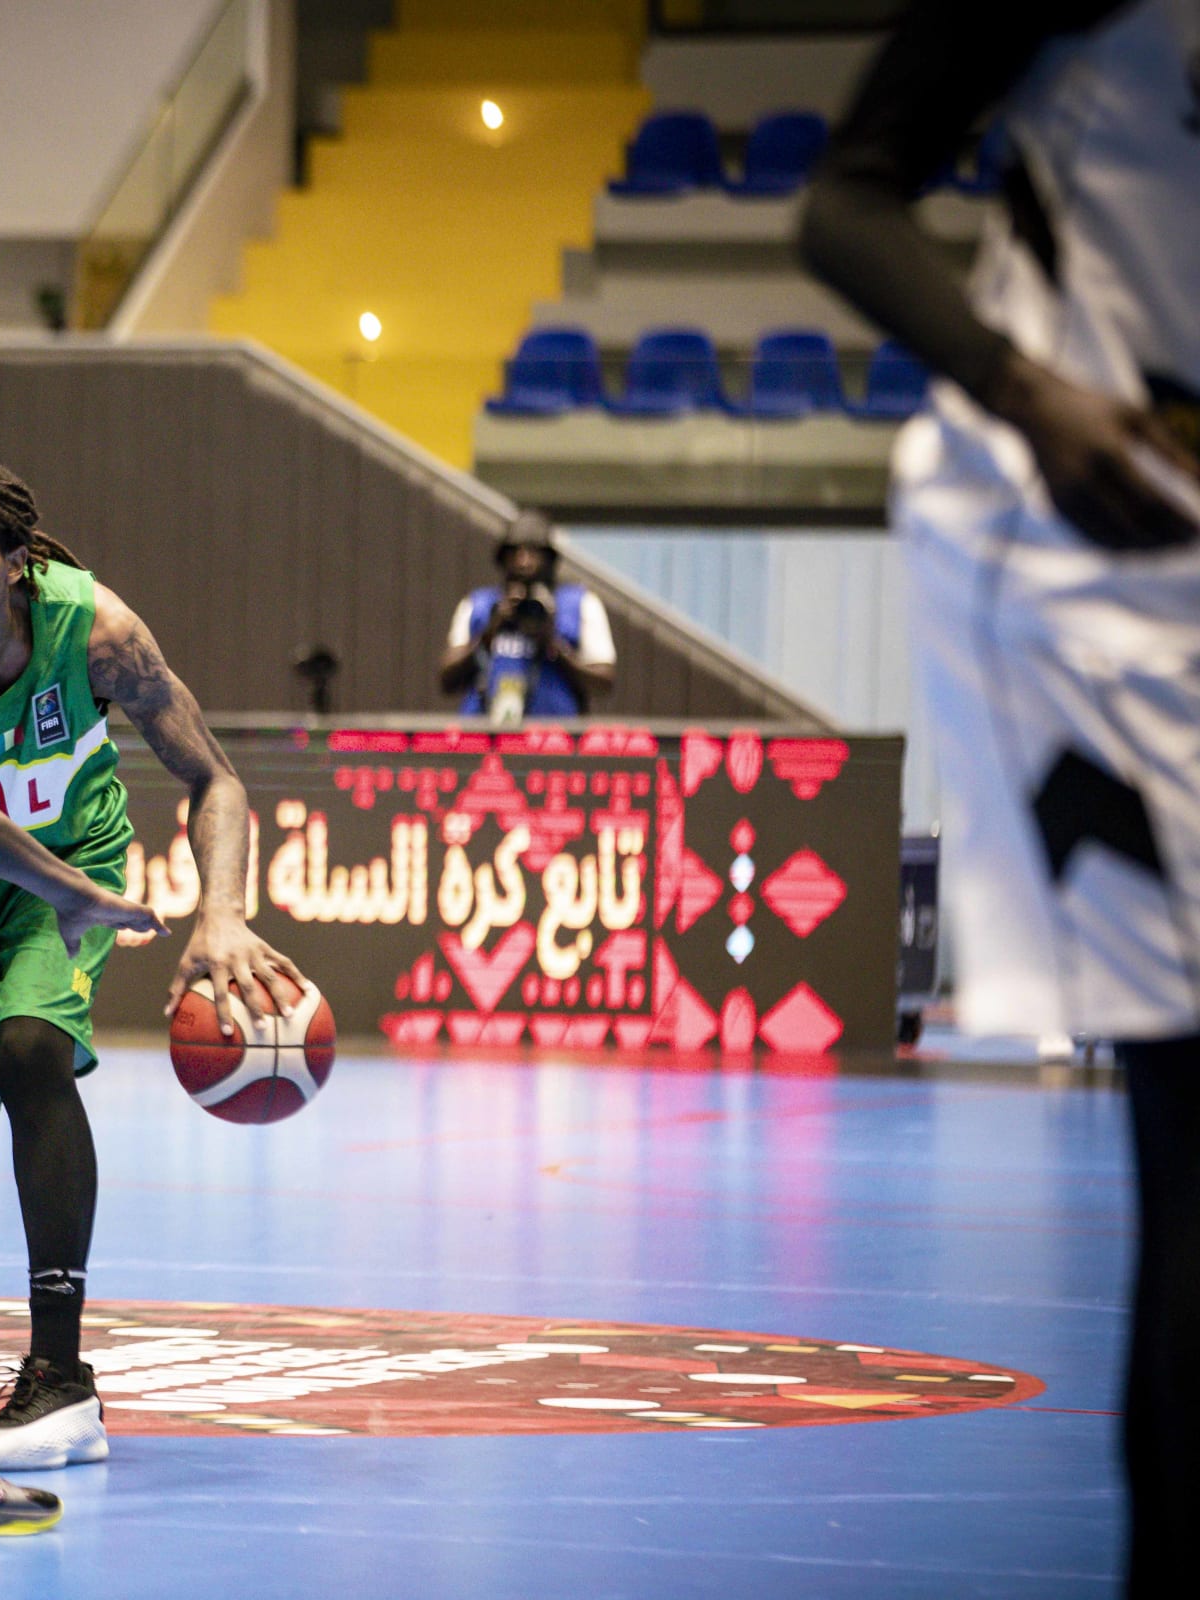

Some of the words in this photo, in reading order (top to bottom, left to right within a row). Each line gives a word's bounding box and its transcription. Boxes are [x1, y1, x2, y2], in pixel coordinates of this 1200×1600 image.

[41, 717, 59, 731] FIBA
[268, 799, 429, 925] السلة
[437, 812, 531, 951] كرة
[536, 826, 644, 979] تابع
